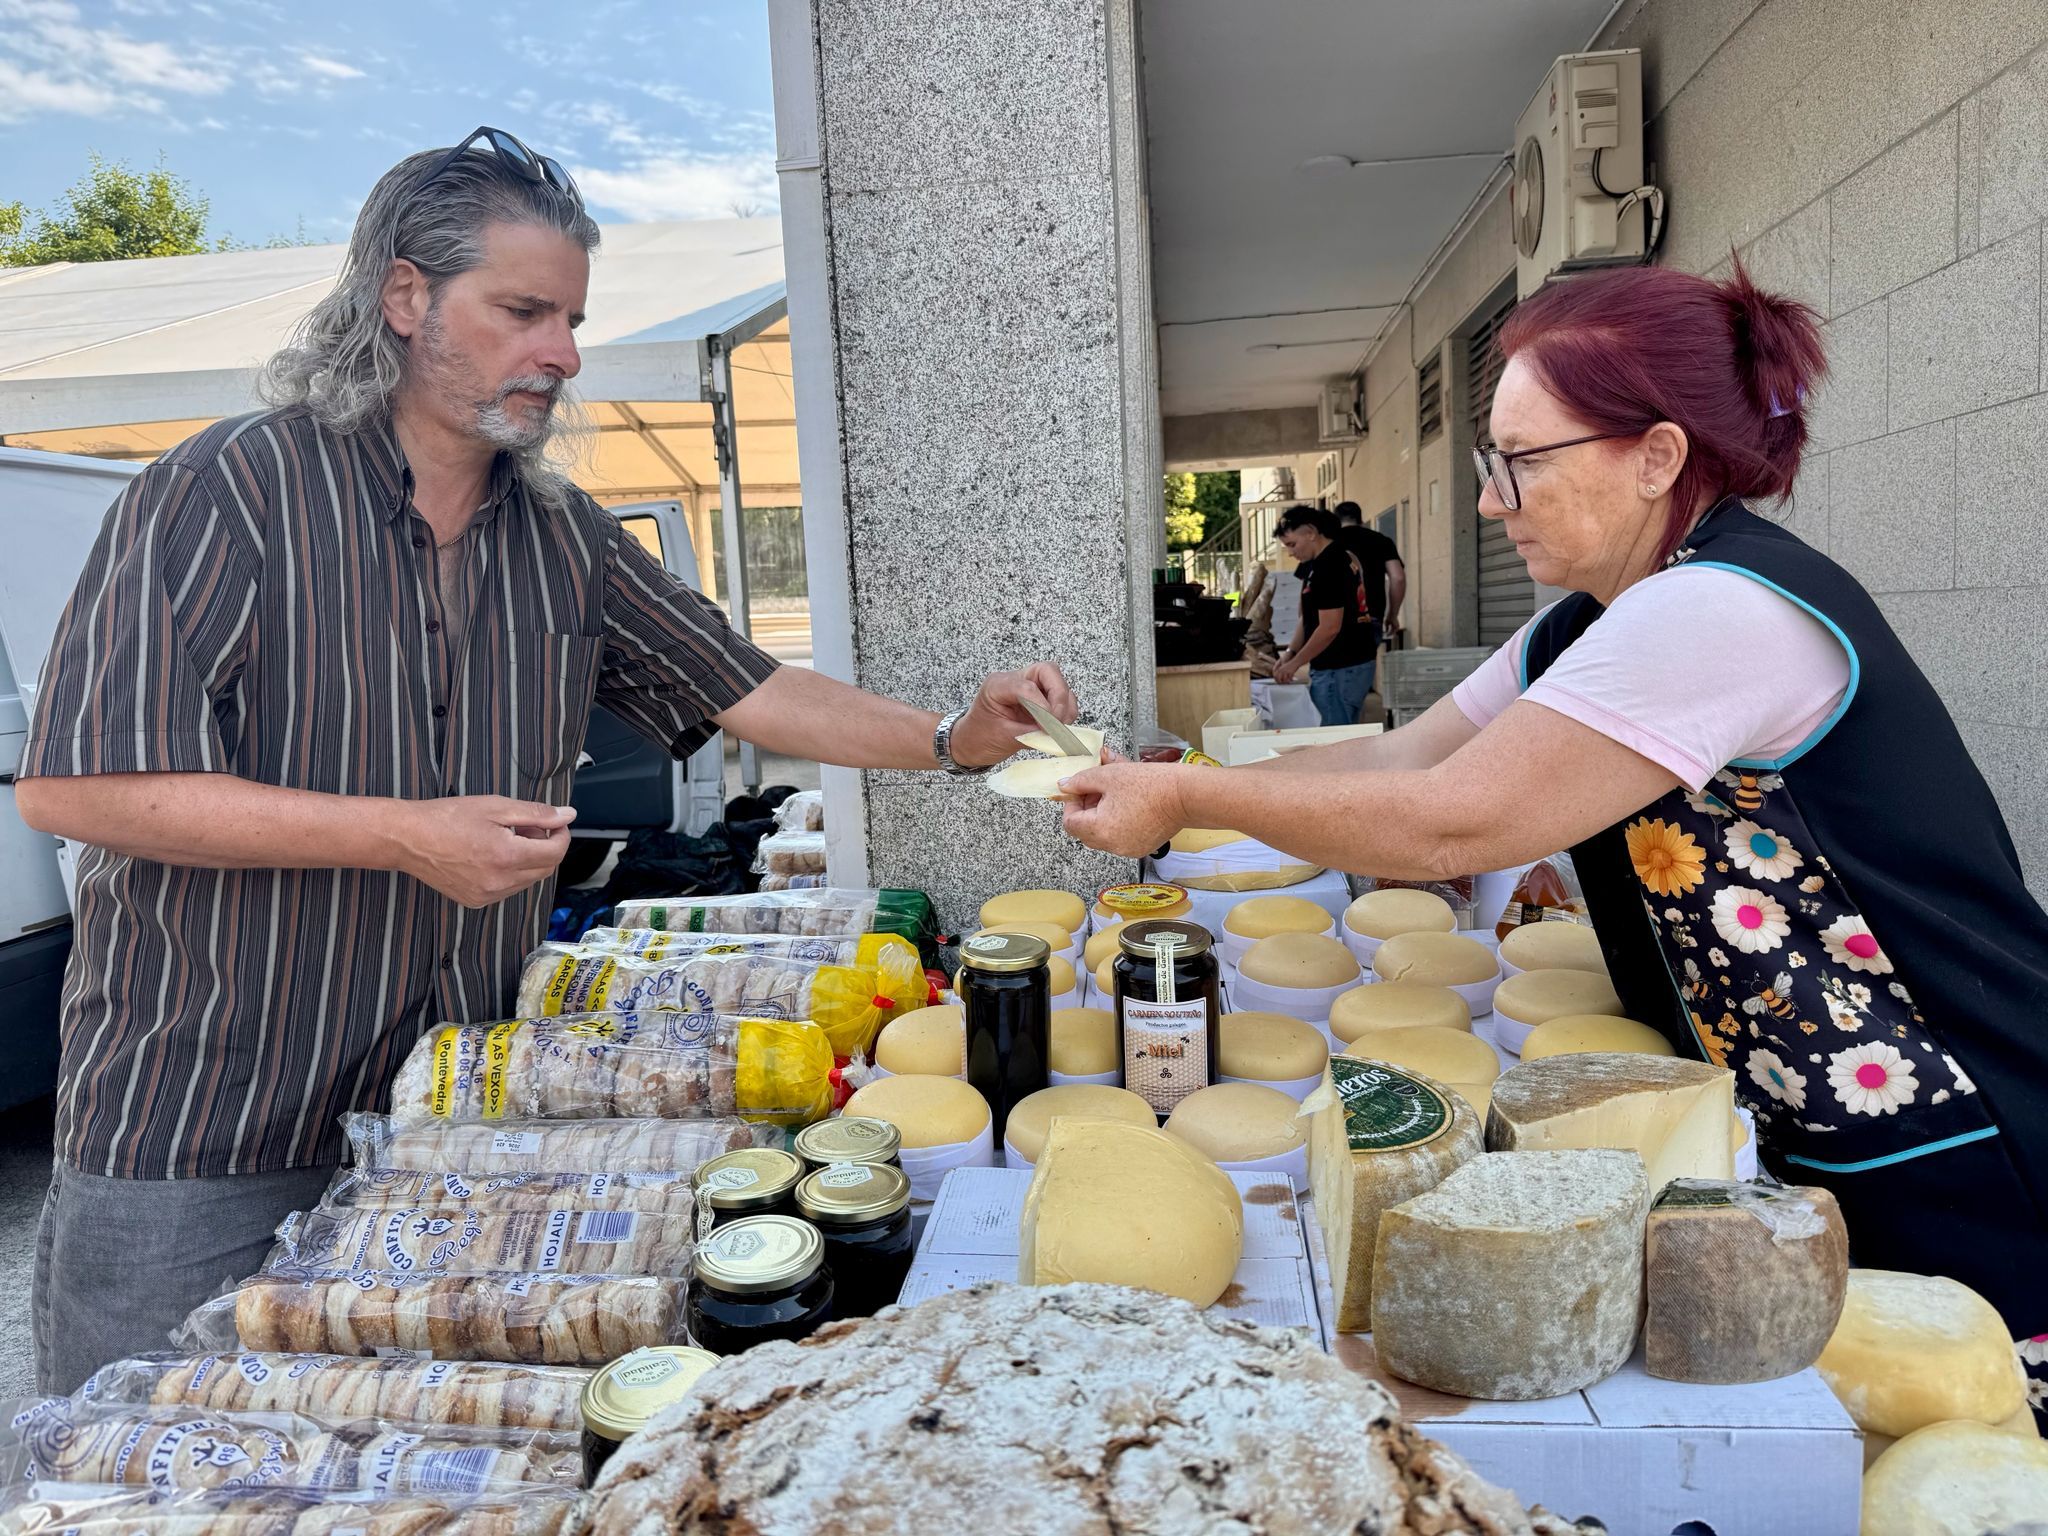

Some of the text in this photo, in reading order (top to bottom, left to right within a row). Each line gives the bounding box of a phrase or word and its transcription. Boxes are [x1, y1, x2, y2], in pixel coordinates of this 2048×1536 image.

[1128, 1009, 1163, 1018] CARMEN
[460, 1041, 470, 1054] 64
[493, 1044, 504, 1060] AS
[1148, 1044, 1184, 1057] Miel
[459, 1058, 470, 1071] 08
[433, 1040, 451, 1116] (Pontevedra)
[458, 1075, 469, 1090] 34
[474, 1071, 484, 1084] 16
[827, 1170, 863, 1180] Calidad
[432, 1220, 445, 1232] AS
[701, 1216, 709, 1227] de
[623, 1360, 669, 1378] Calidad
[15, 1414, 29, 1425] EN
[218, 1447, 236, 1461] AS
